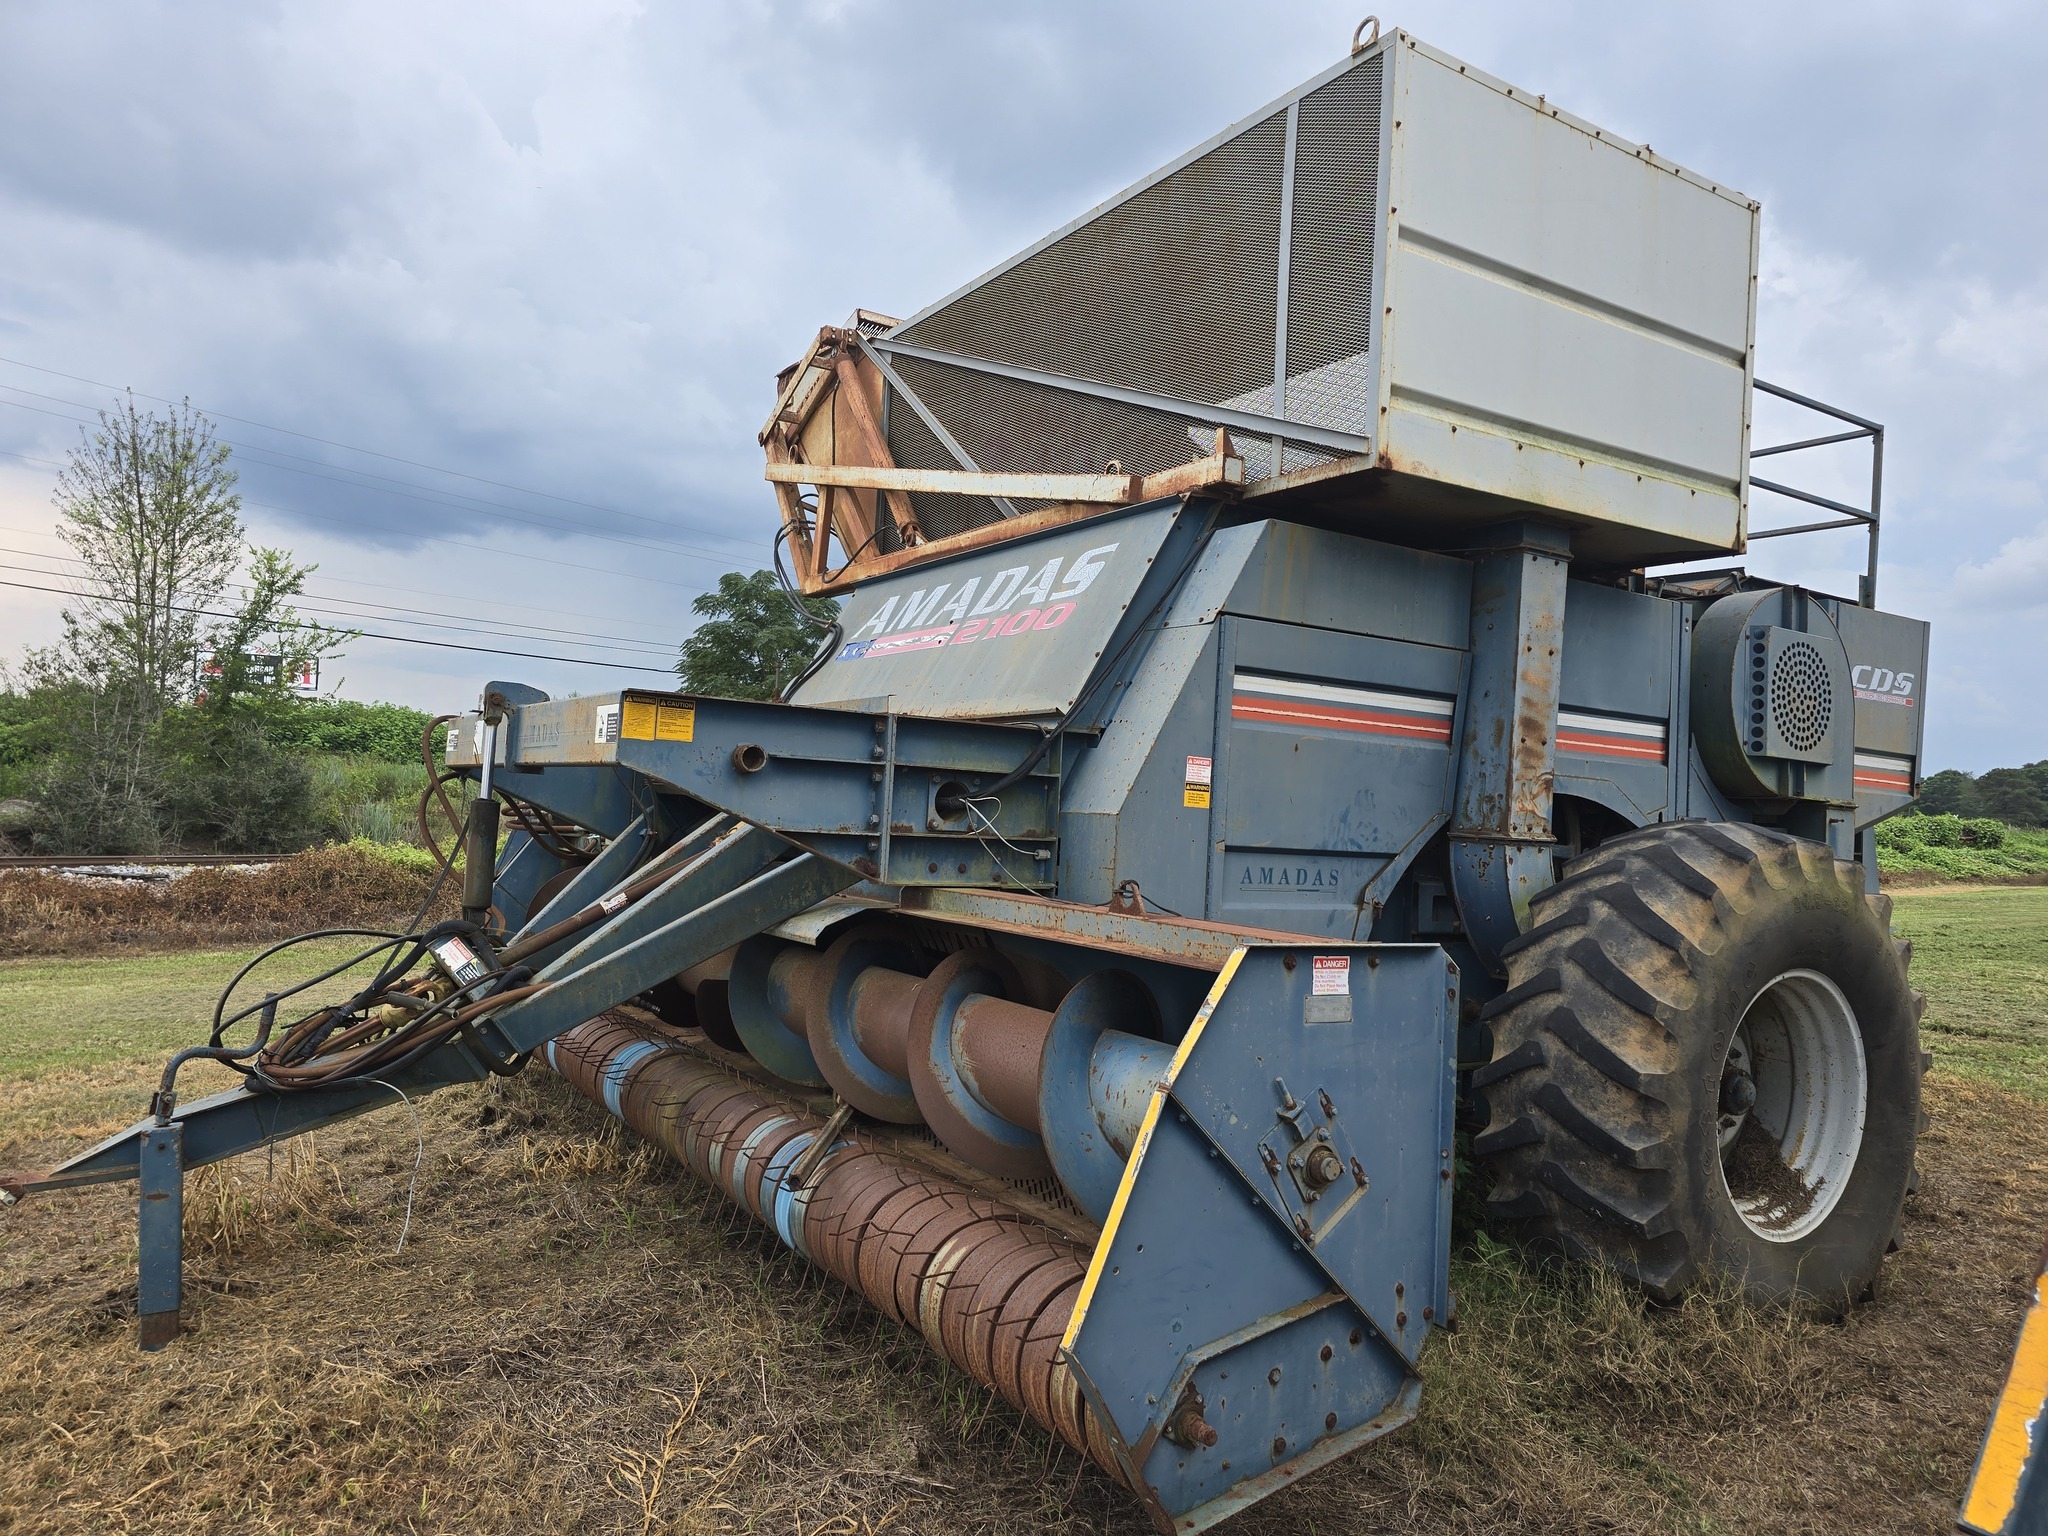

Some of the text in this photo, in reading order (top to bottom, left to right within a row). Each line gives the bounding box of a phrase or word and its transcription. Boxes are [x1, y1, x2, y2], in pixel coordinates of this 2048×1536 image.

[851, 542, 1120, 638] AMADAS
[949, 602, 1077, 645] 2100
[1852, 665, 1915, 696] CDS
[632, 696, 656, 704] WARNING
[666, 700, 694, 708] CAUTION
[1240, 866, 1339, 887] AMADAS
[1322, 960, 1347, 968] DANGER
